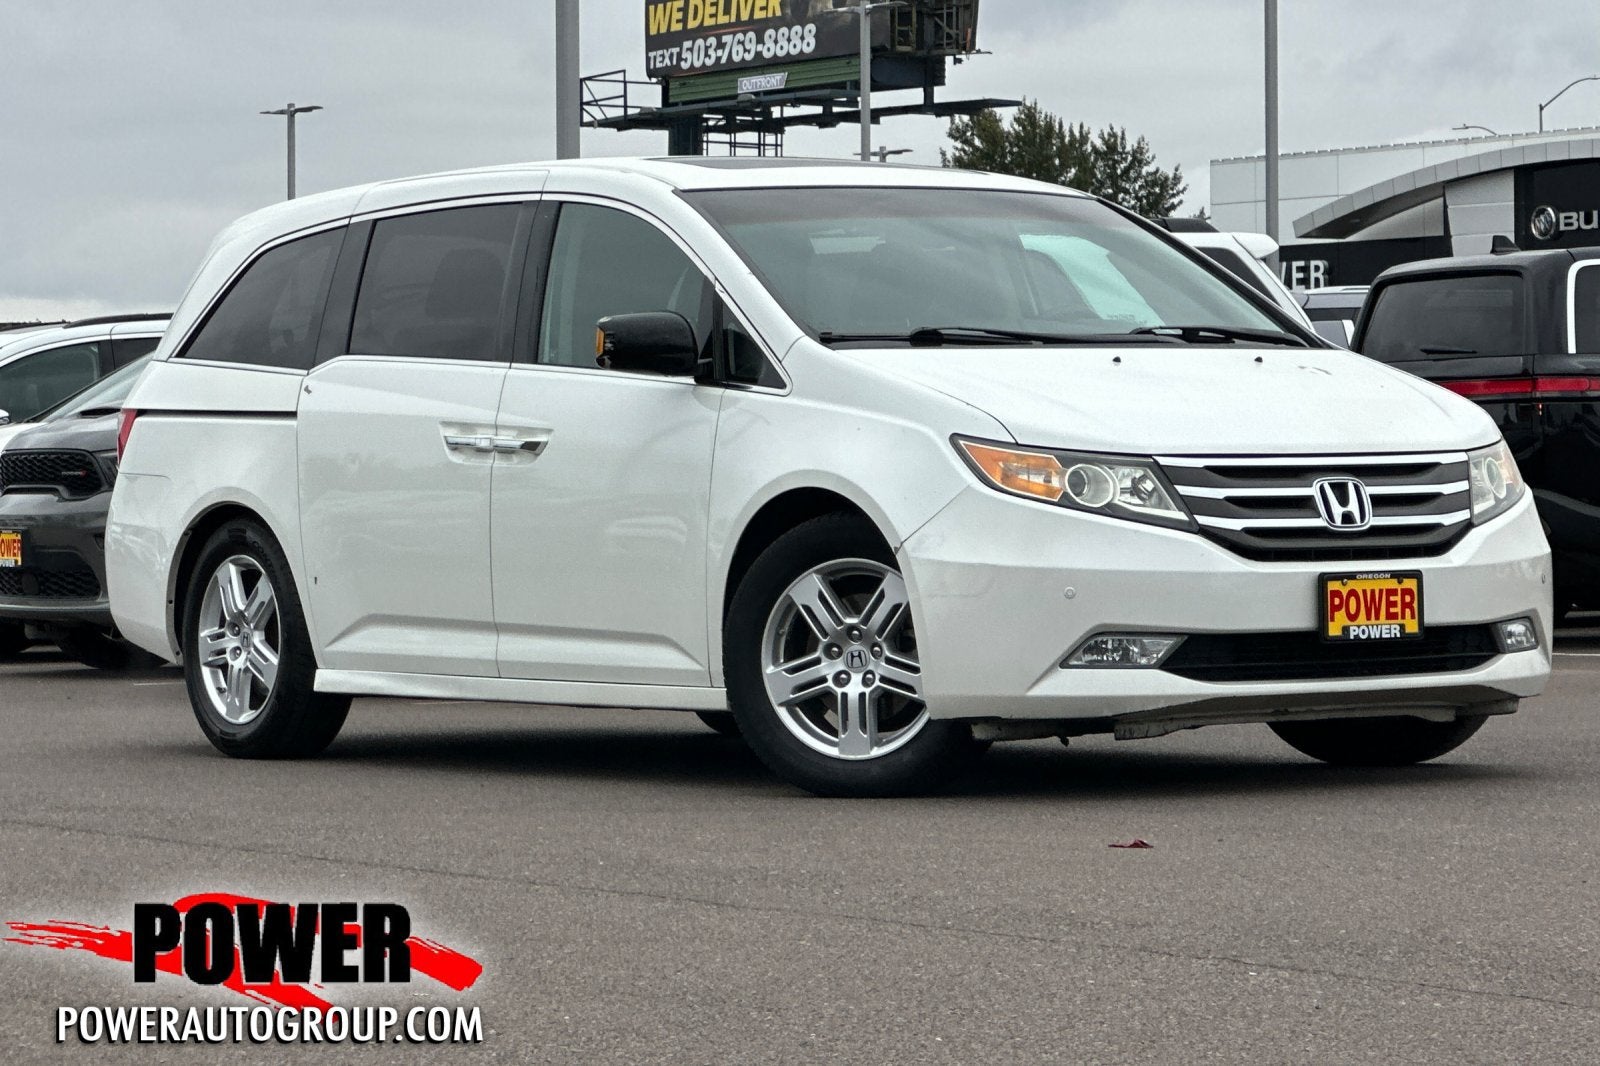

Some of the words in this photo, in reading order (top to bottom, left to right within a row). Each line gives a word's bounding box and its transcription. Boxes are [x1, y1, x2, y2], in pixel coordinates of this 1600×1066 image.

[648, 1, 683, 36] WE
[687, 0, 782, 29] DELIVER
[648, 46, 680, 70] TEXT
[680, 22, 817, 70] 503-769-8888
[742, 74, 783, 91] OUTFRONT
[1559, 209, 1599, 231] BU
[1355, 572, 1391, 580] OREGON
[1329, 587, 1416, 622] POWER
[1349, 624, 1401, 640] POWER
